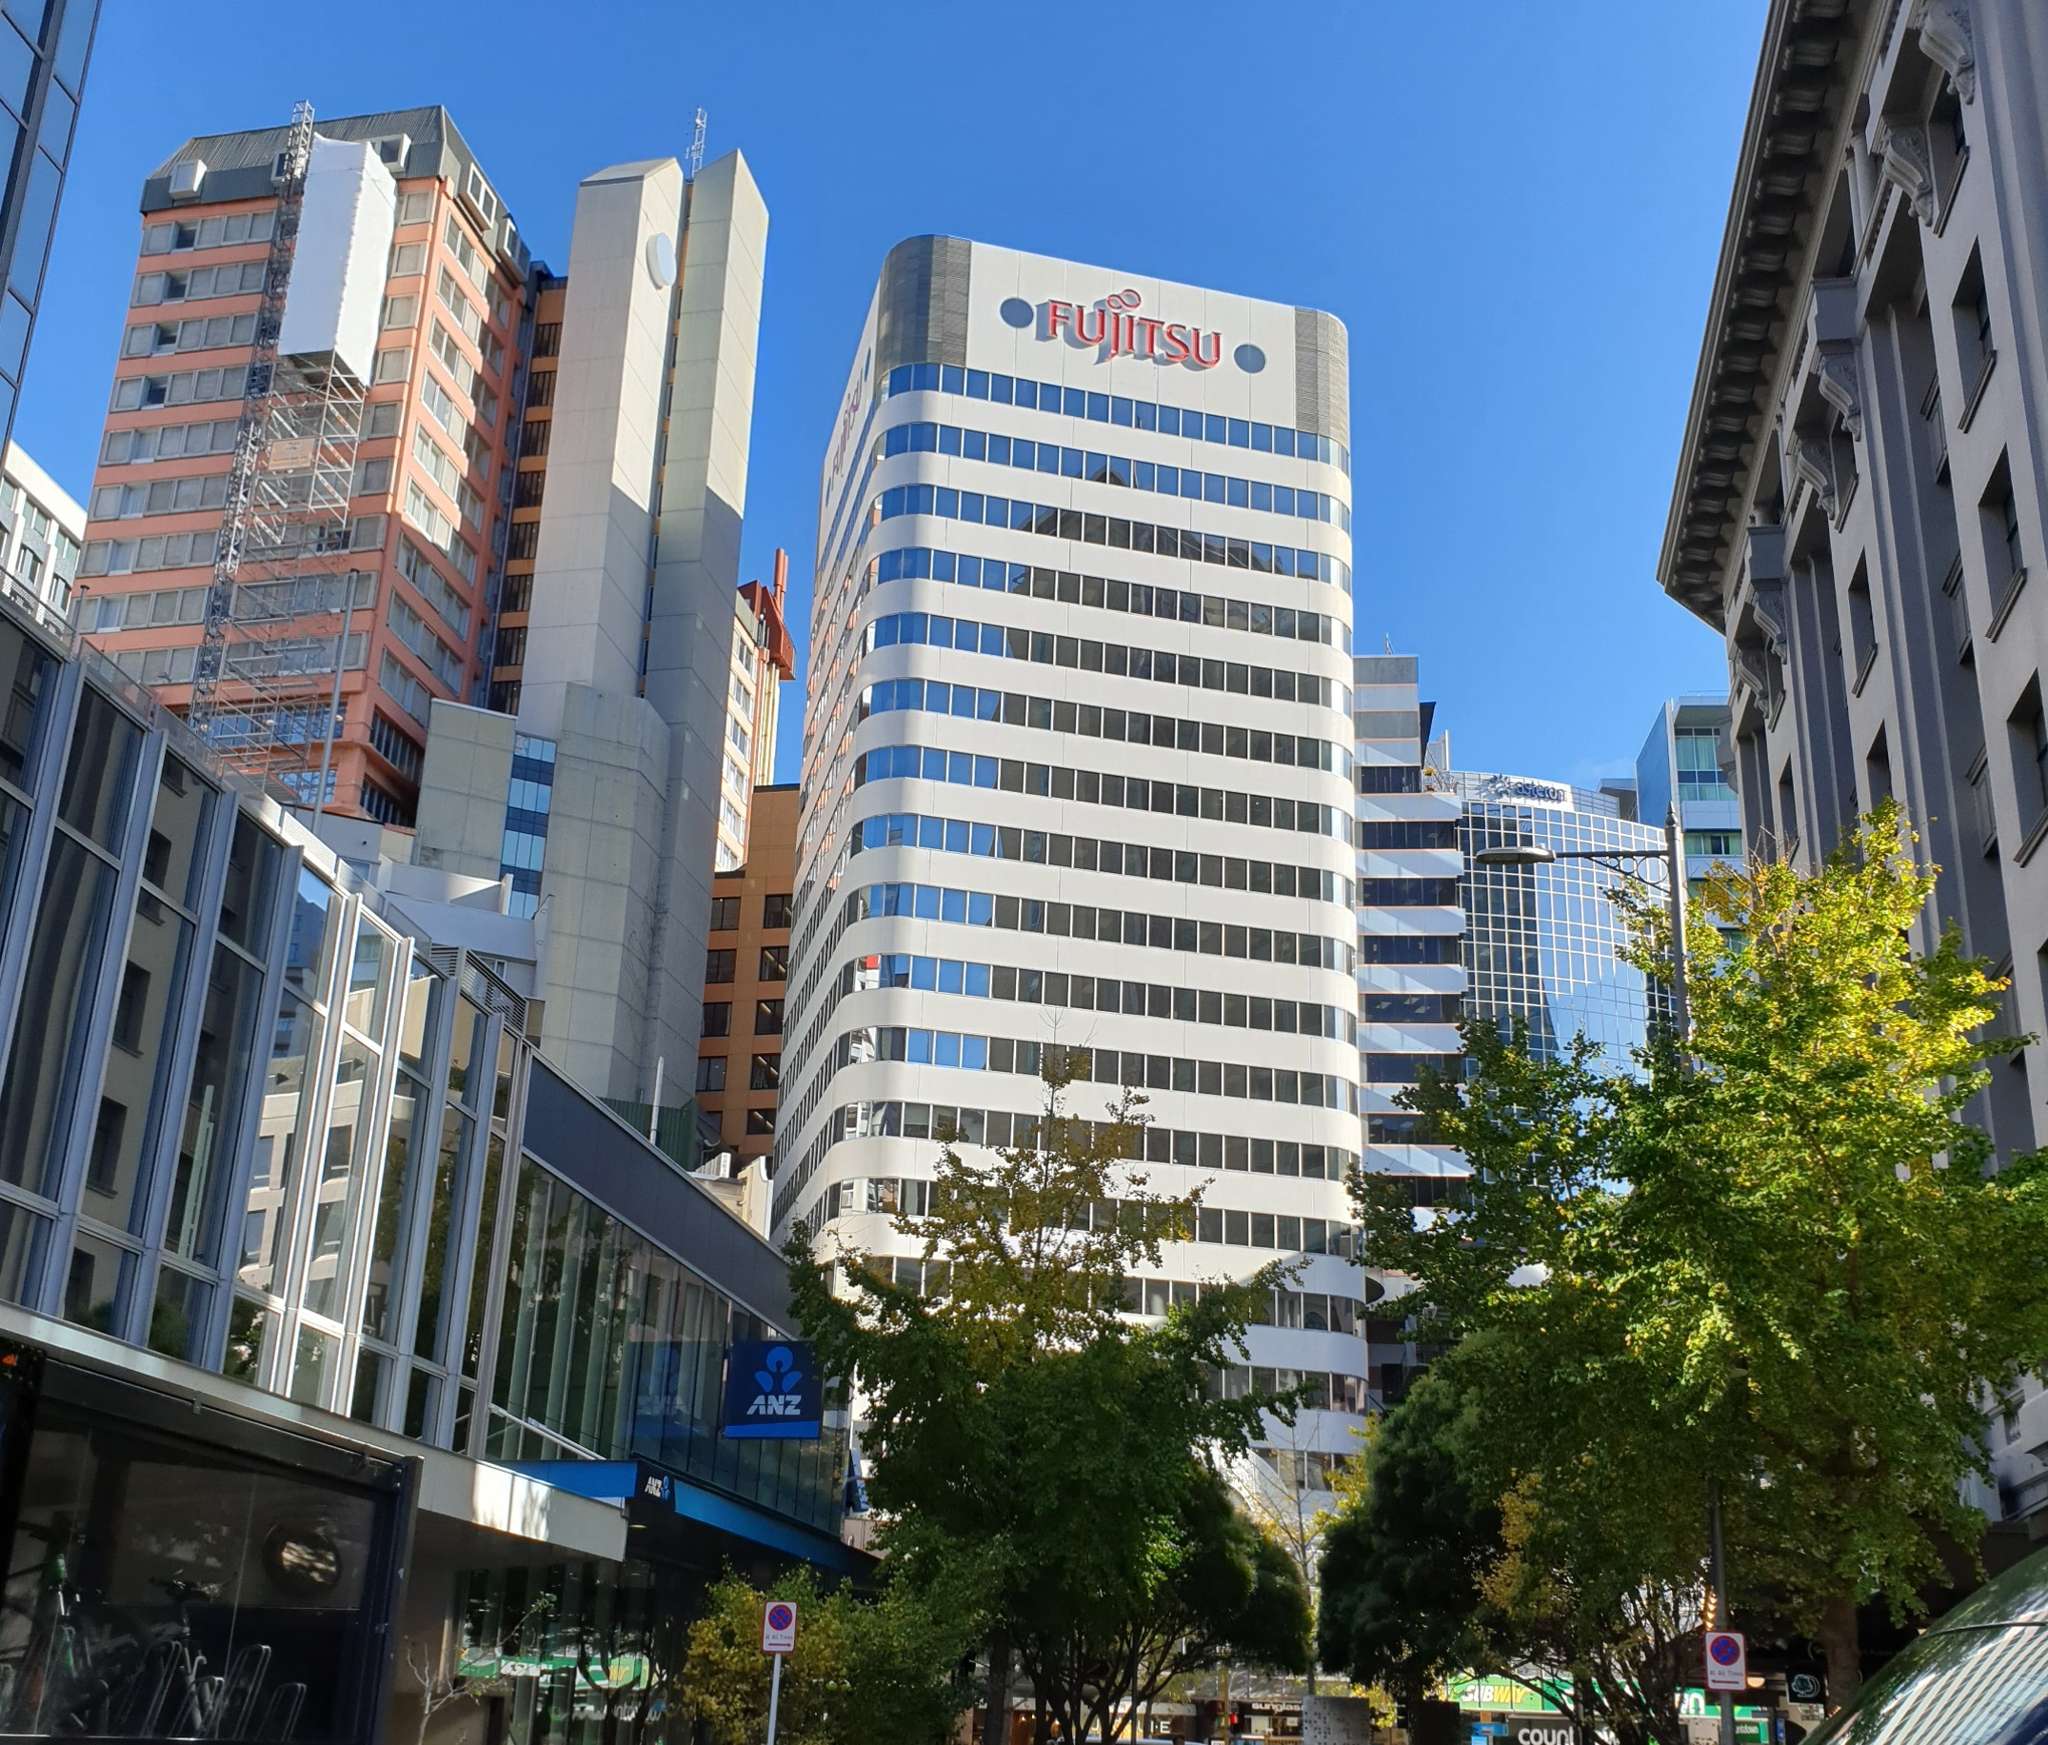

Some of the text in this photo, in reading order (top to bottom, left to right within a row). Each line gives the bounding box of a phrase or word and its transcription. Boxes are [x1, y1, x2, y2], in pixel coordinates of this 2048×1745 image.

[1047, 289, 1222, 369] FUJITSU
[747, 1395, 802, 1416] ANZ
[644, 1476, 662, 1498] ANZ
[1462, 1685, 1525, 1703] SUBWAY
